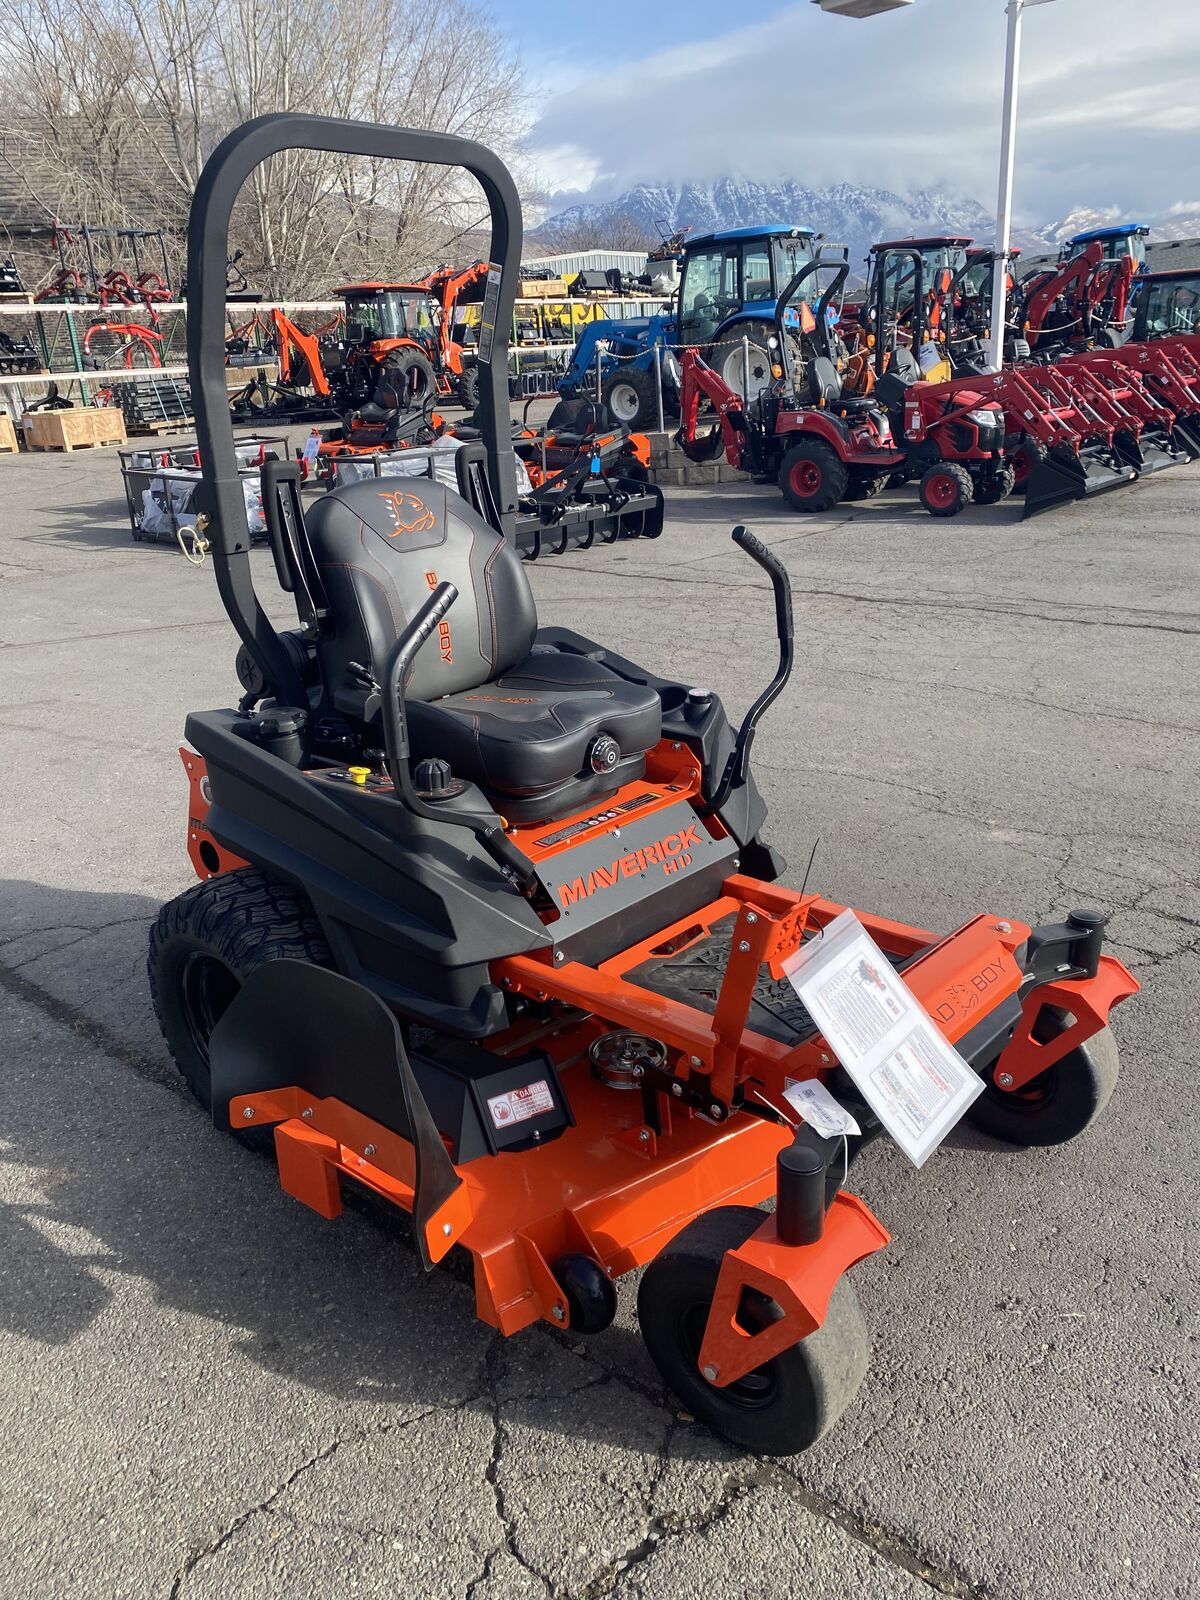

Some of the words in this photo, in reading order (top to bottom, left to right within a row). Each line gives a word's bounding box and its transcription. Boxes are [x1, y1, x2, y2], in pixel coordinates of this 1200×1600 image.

[437, 619, 453, 665] BOY
[557, 823, 703, 909] MAVERICK
[663, 853, 693, 876] HD
[970, 957, 1008, 992] BOY
[518, 1082, 547, 1098] DANGER
